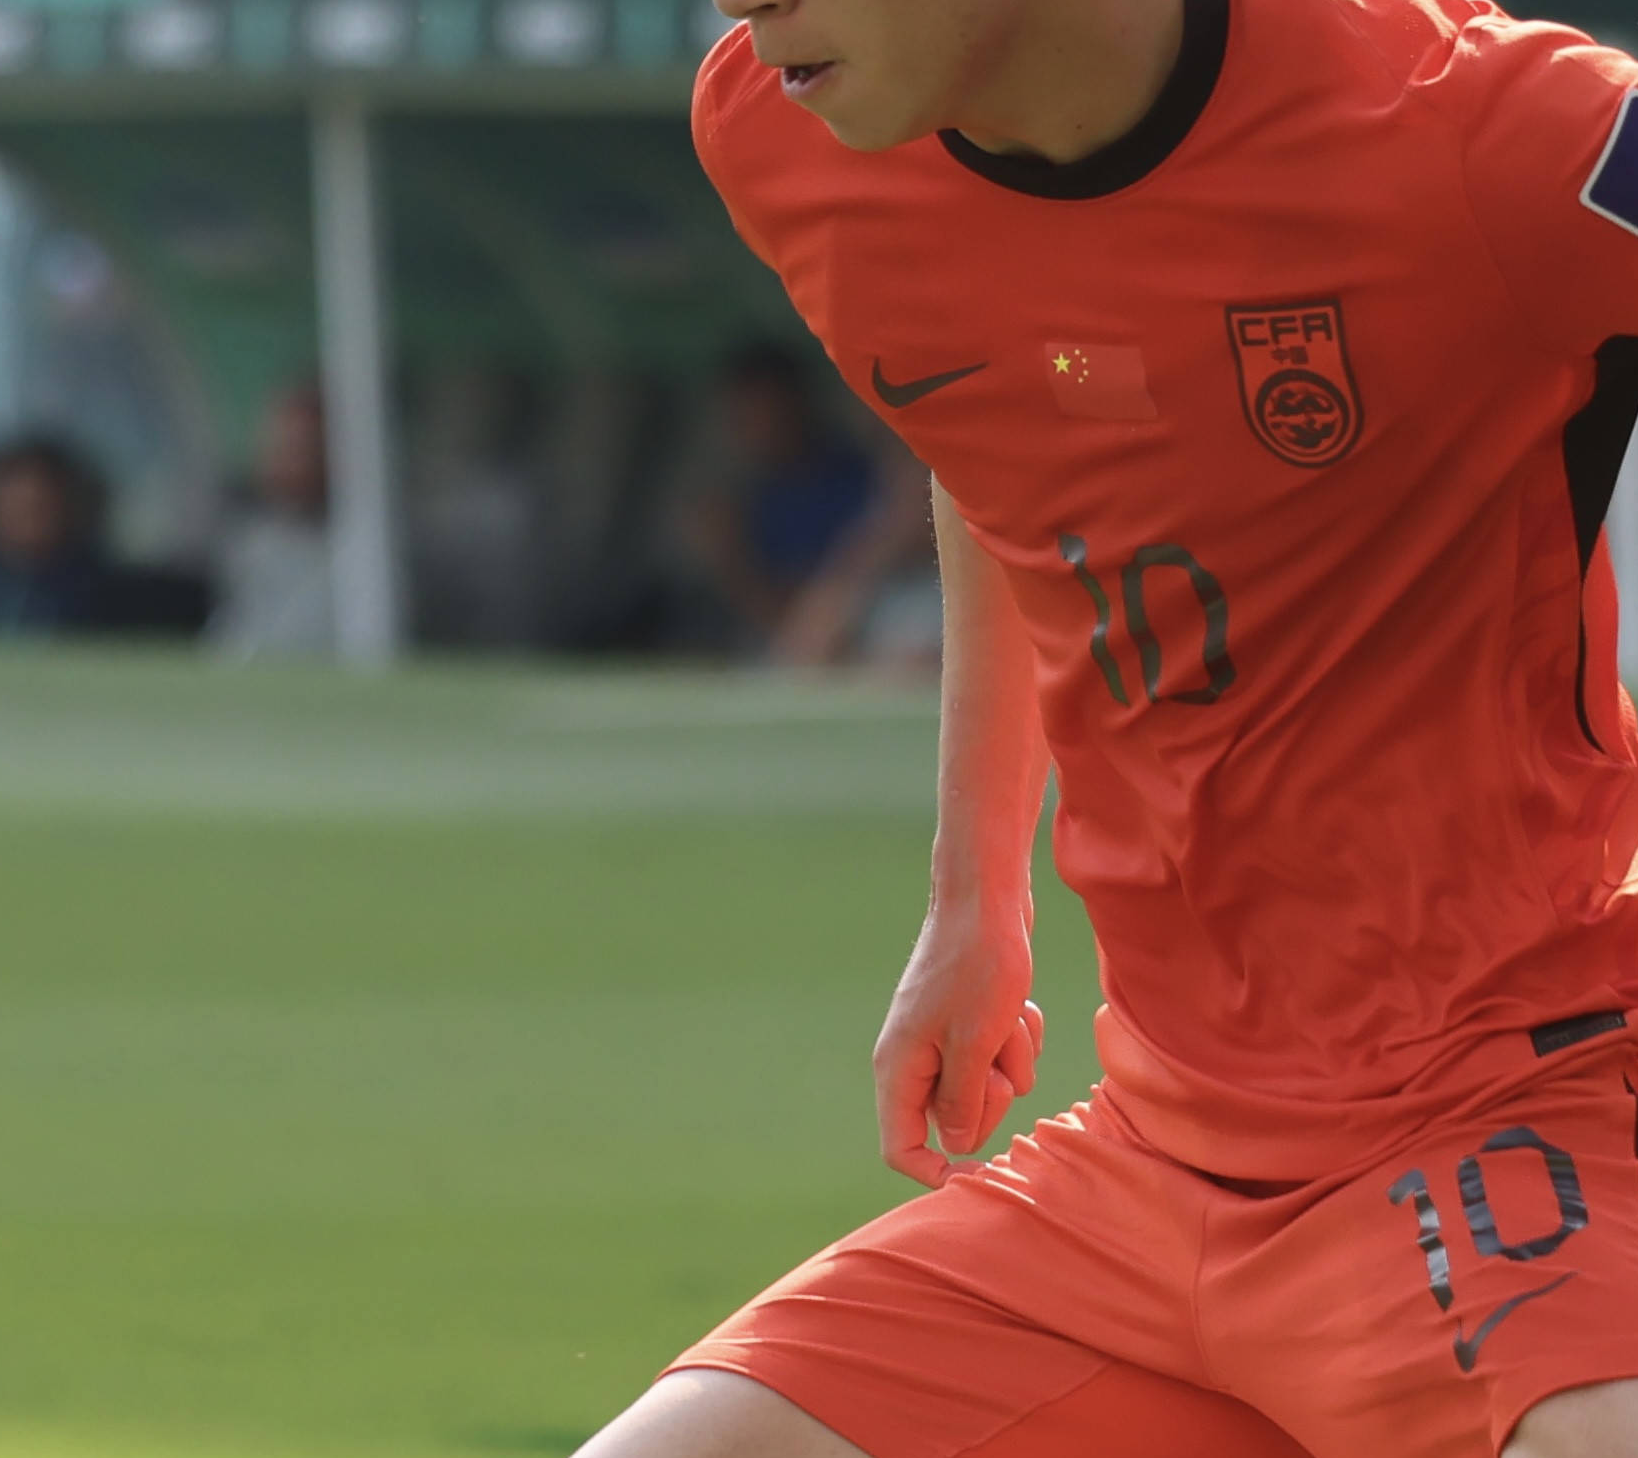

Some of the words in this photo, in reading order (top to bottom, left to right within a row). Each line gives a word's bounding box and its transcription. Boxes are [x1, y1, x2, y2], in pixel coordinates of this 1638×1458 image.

[1237, 312, 1333, 347] CFA
[1057, 533, 1237, 708] 10
[1388, 1127, 1588, 1313] 10
